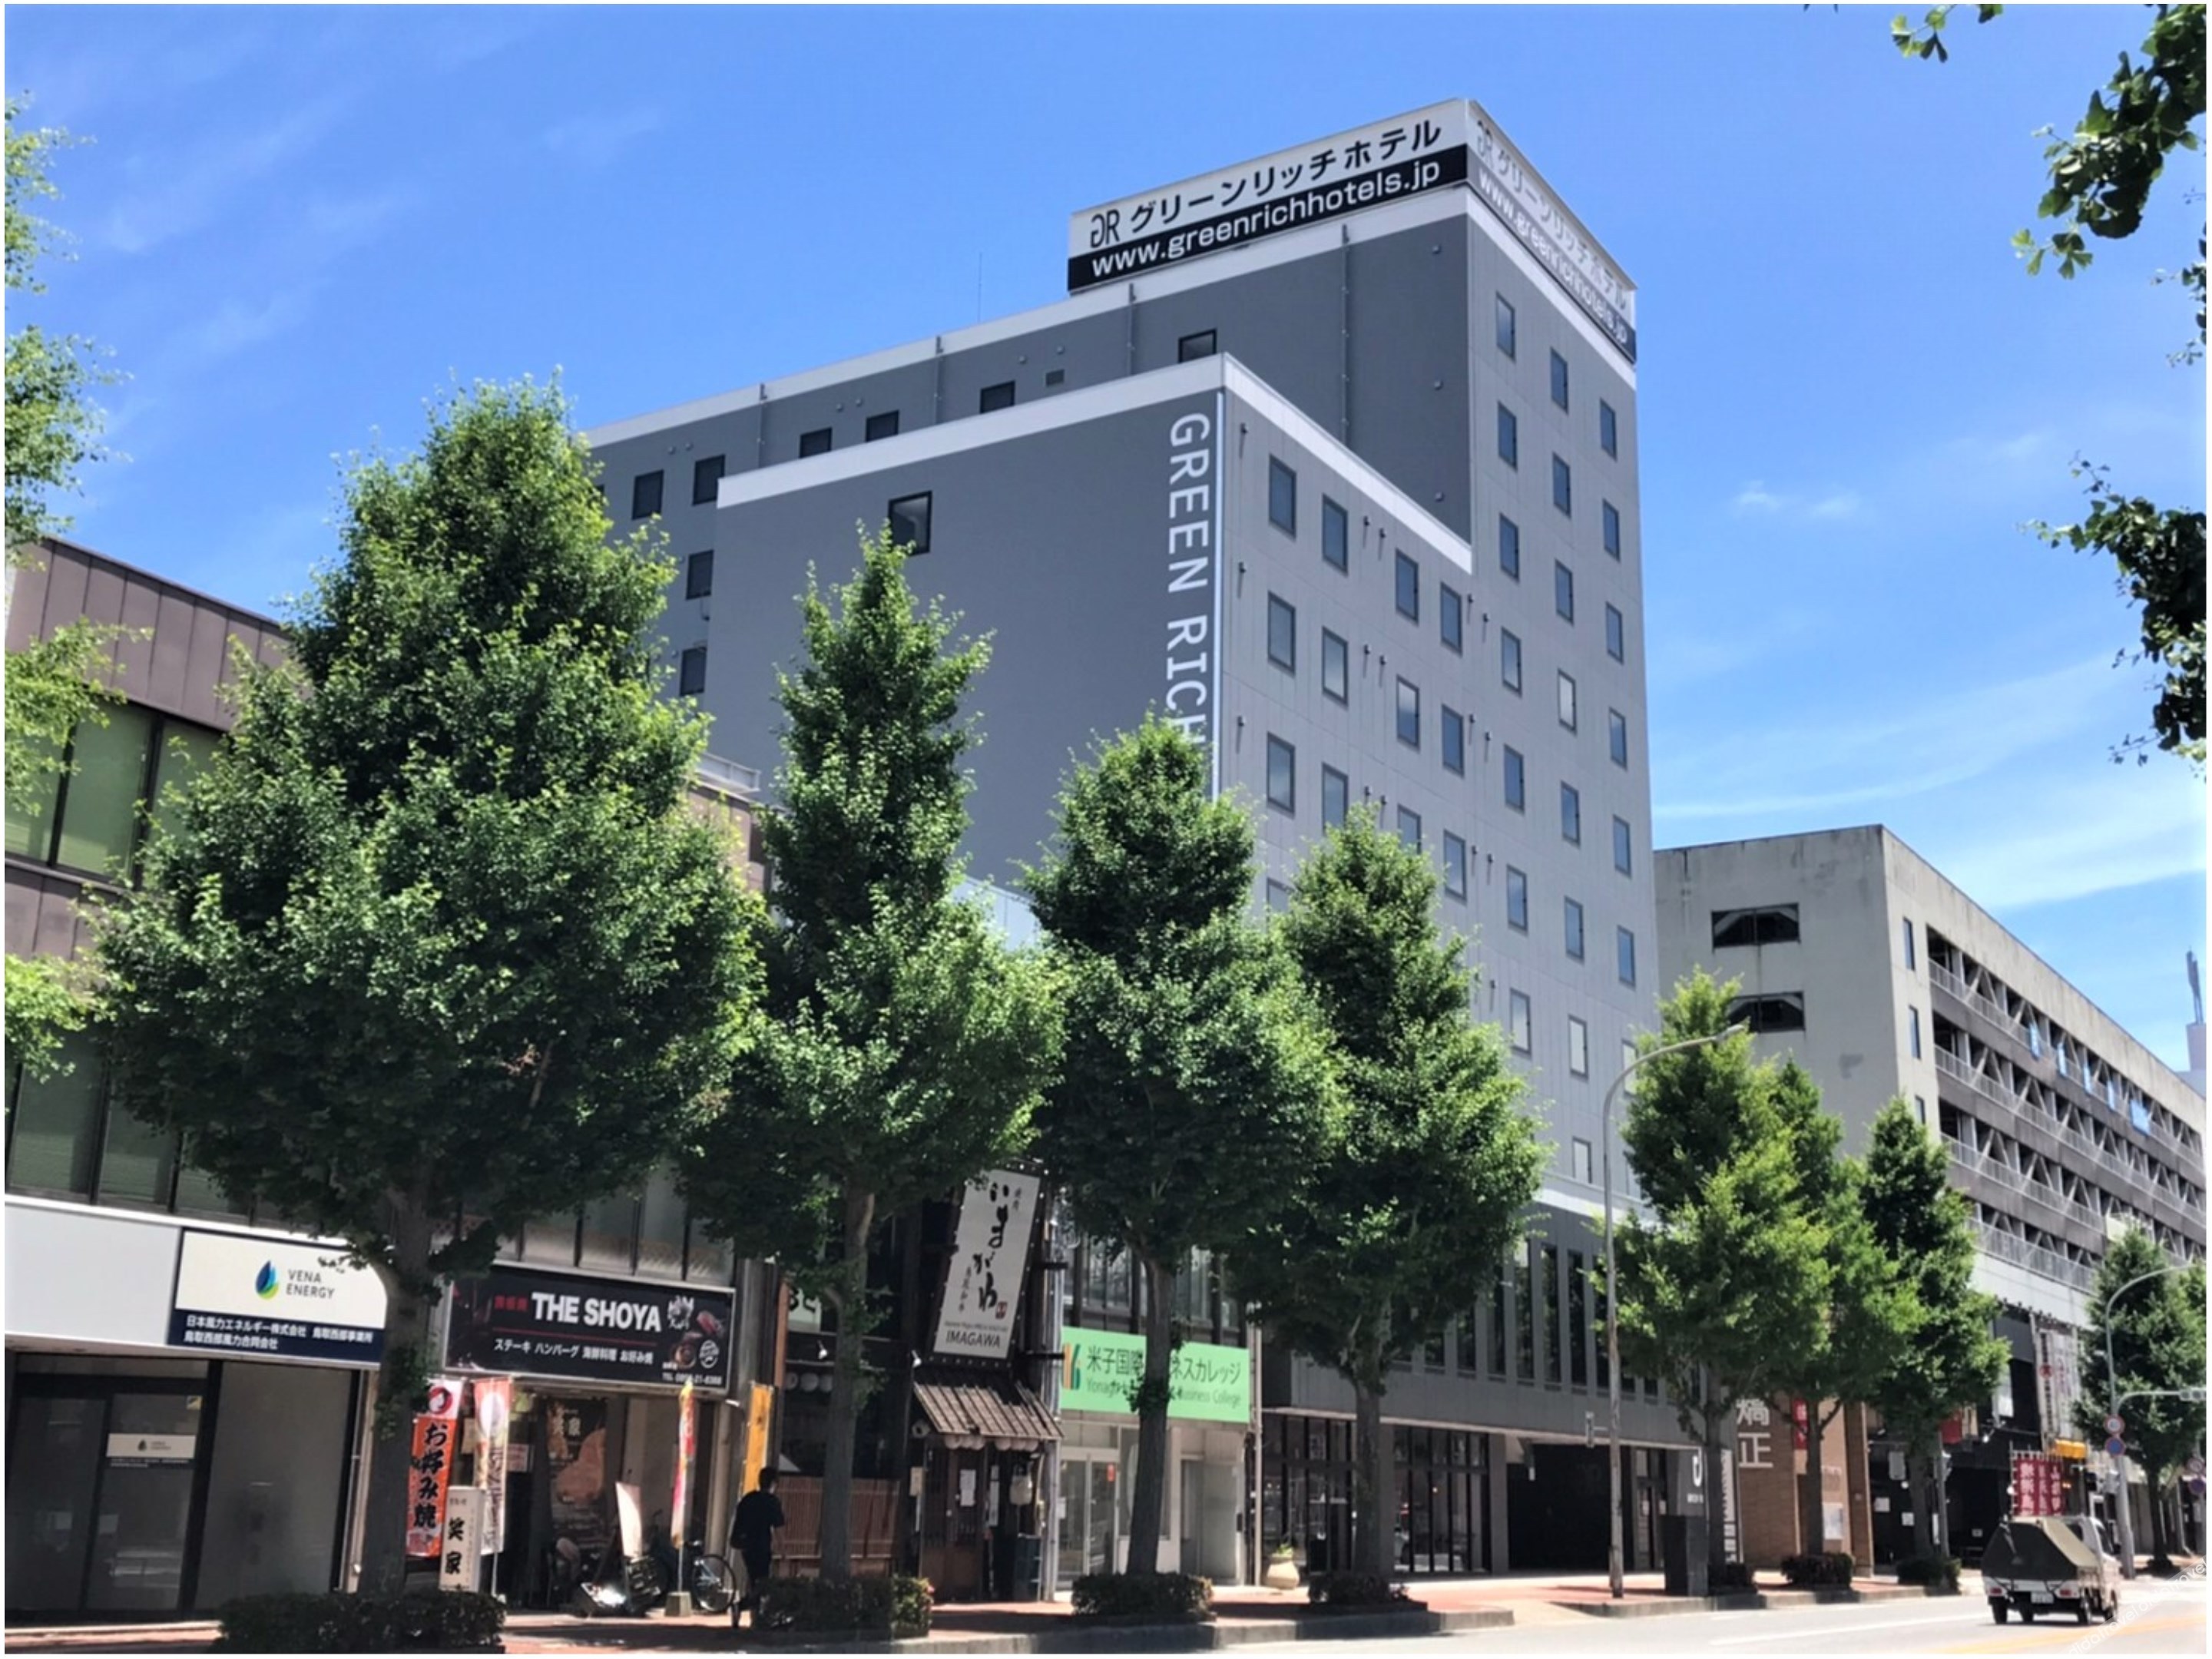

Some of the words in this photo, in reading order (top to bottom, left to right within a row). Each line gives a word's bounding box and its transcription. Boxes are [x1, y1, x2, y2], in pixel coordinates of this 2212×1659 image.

[1131, 119, 1441, 232] グリーンリッチホテル
[1091, 160, 1439, 278] www.greenrichhotels.jp
[1168, 412, 1210, 593] GREEN
[1165, 615, 1208, 743] RICH
[286, 1283, 335, 1300] ENERGY
[288, 1270, 322, 1283] VENA
[531, 1292, 580, 1324] THE
[583, 1297, 662, 1333] SHOYA
[494, 1339, 531, 1354] ステーキ
[534, 1343, 581, 1359] ハンバーグ
[945, 1330, 1002, 1349] IMAGAWA
[1087, 1346, 1242, 1386] 米子国際ネスカレッジ
[412, 1423, 449, 1528] お好み焼
